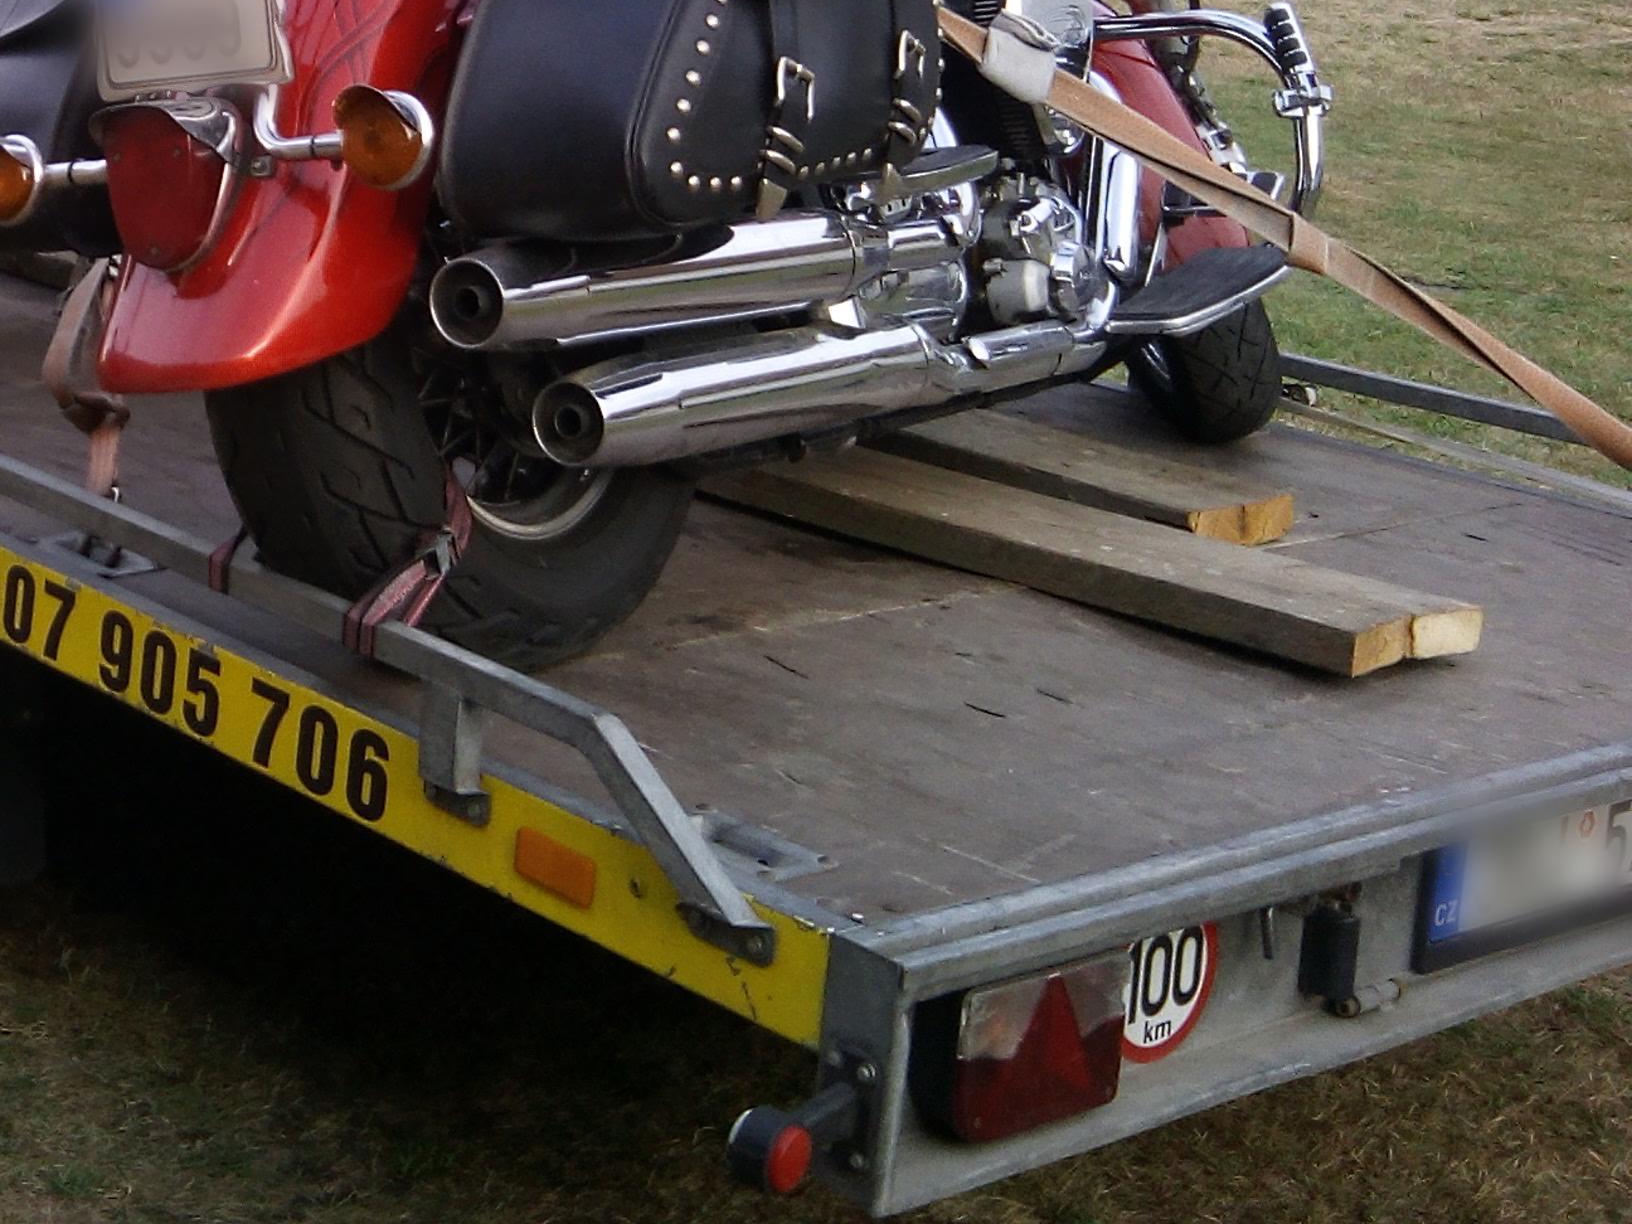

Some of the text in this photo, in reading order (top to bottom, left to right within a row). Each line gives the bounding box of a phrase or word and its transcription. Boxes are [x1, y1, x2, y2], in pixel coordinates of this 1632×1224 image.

[99, 610, 222, 738] 905
[251, 677, 390, 822] 706
[1434, 899, 1459, 927] CZ
[1128, 927, 1204, 1025] 100
[1143, 1020, 1172, 1044] km
